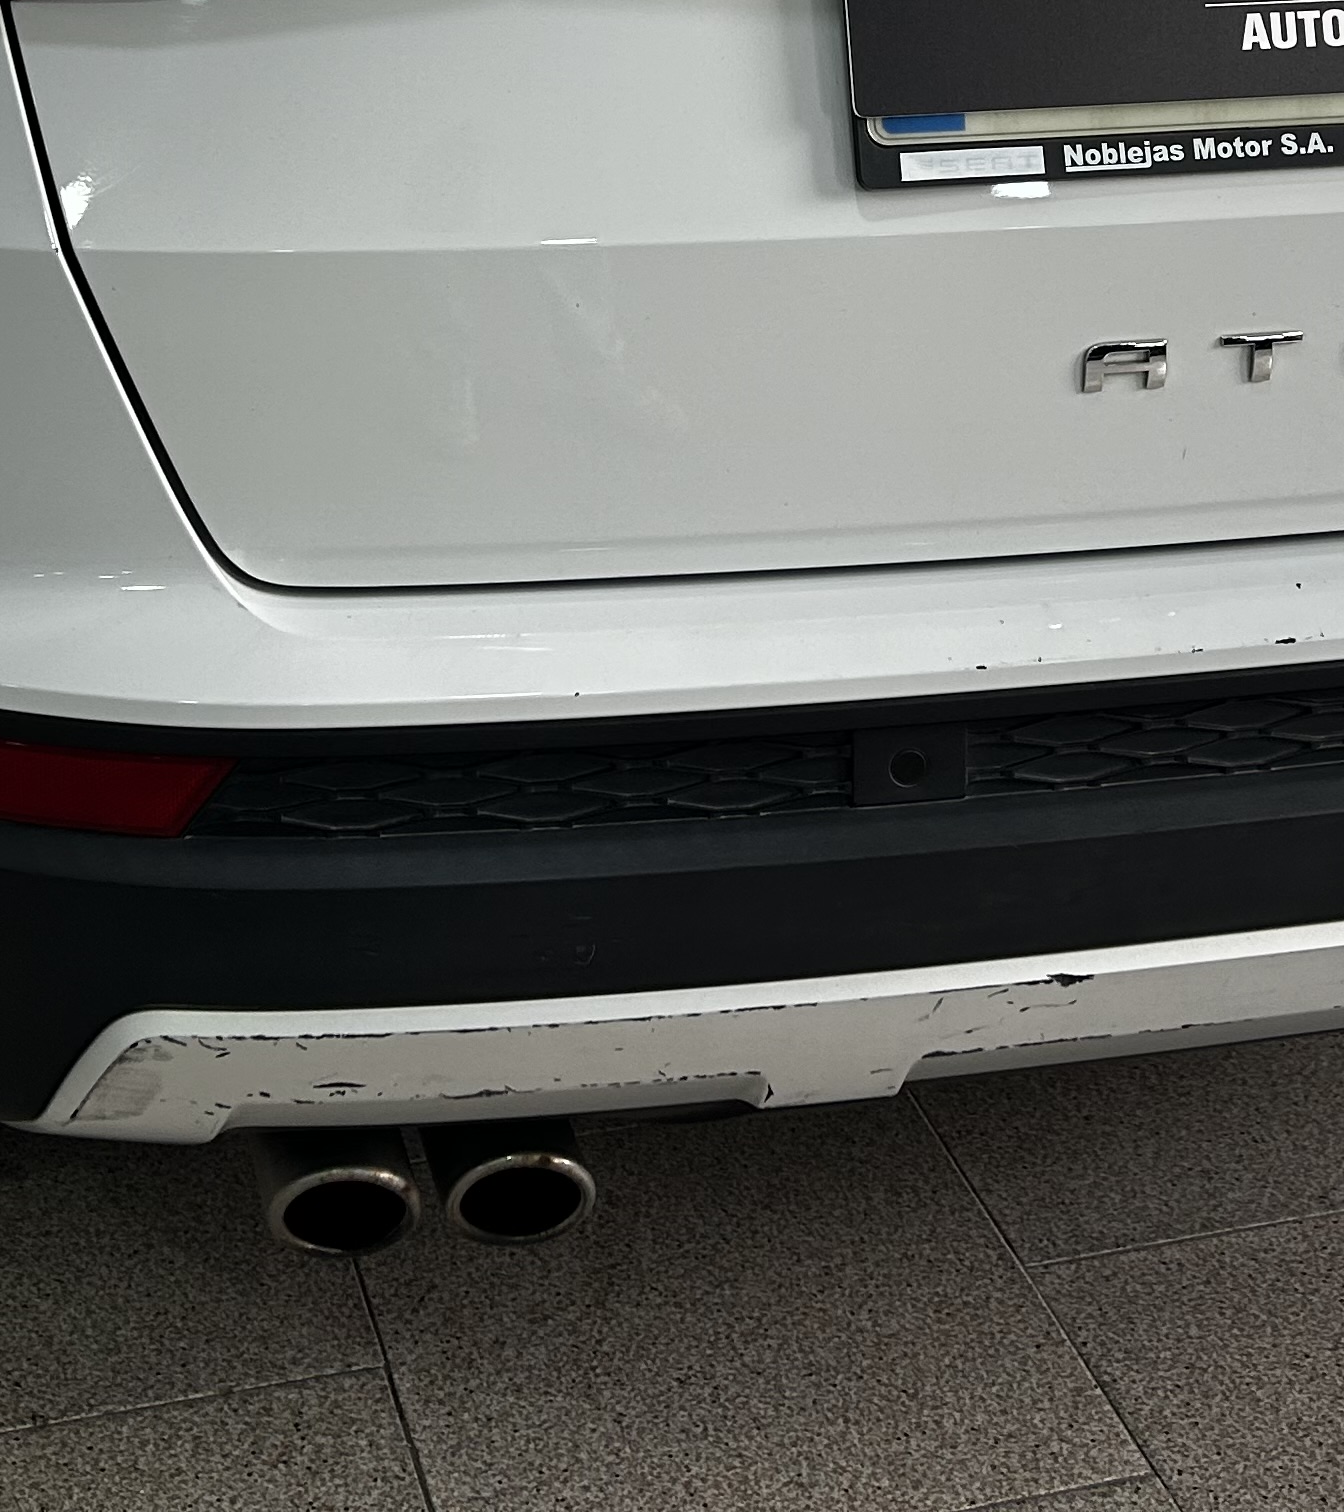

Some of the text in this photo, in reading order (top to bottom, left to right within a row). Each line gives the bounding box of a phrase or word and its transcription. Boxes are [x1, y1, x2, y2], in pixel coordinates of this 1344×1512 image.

[1064, 132, 1334, 172] Noblejas Motor S.A.
